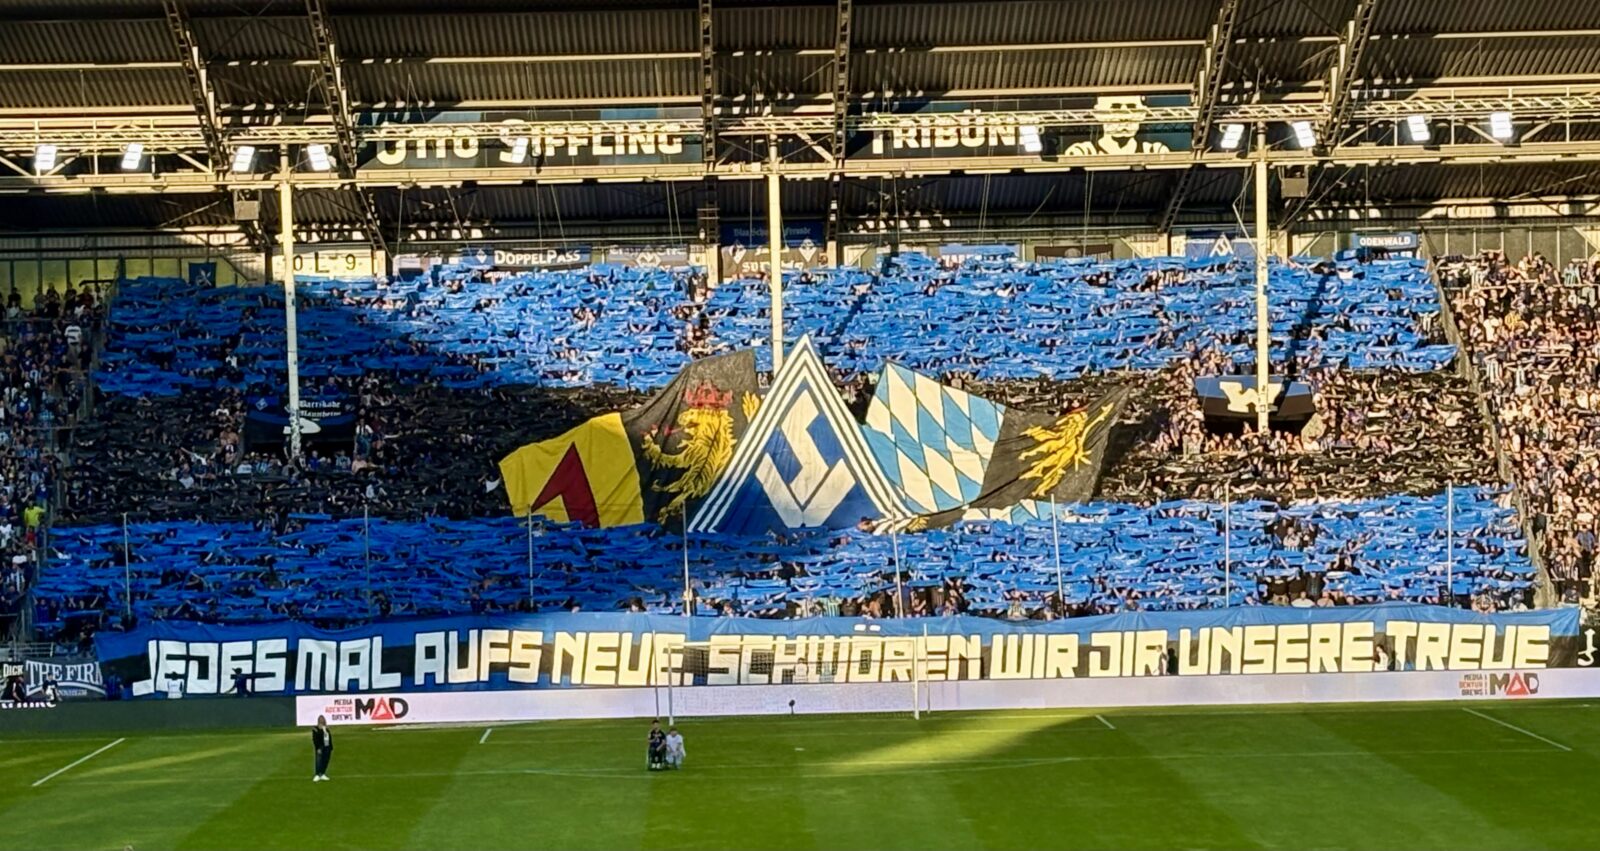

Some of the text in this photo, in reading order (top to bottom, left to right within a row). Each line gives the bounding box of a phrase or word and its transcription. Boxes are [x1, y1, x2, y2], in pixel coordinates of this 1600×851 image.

[376, 121, 478, 165] OTTO
[499, 119, 682, 163] SIFFLING
[1360, 236, 1411, 246] ODENWALD
[132, 638, 288, 696] JEDES
[295, 636, 401, 690] MAL
[414, 629, 543, 686] AUFS
[706, 624, 981, 686] SCHWÖREN
[989, 633, 1079, 679] WIR
[1089, 629, 1168, 678] DIR
[1178, 621, 1375, 676] UNSERE
[1386, 621, 1551, 671] TREUE
[3, 663, 23, 678] DICK
[26, 660, 63, 688] THE
[1489, 672, 1539, 695] MAD
[355, 697, 409, 720] MAD
